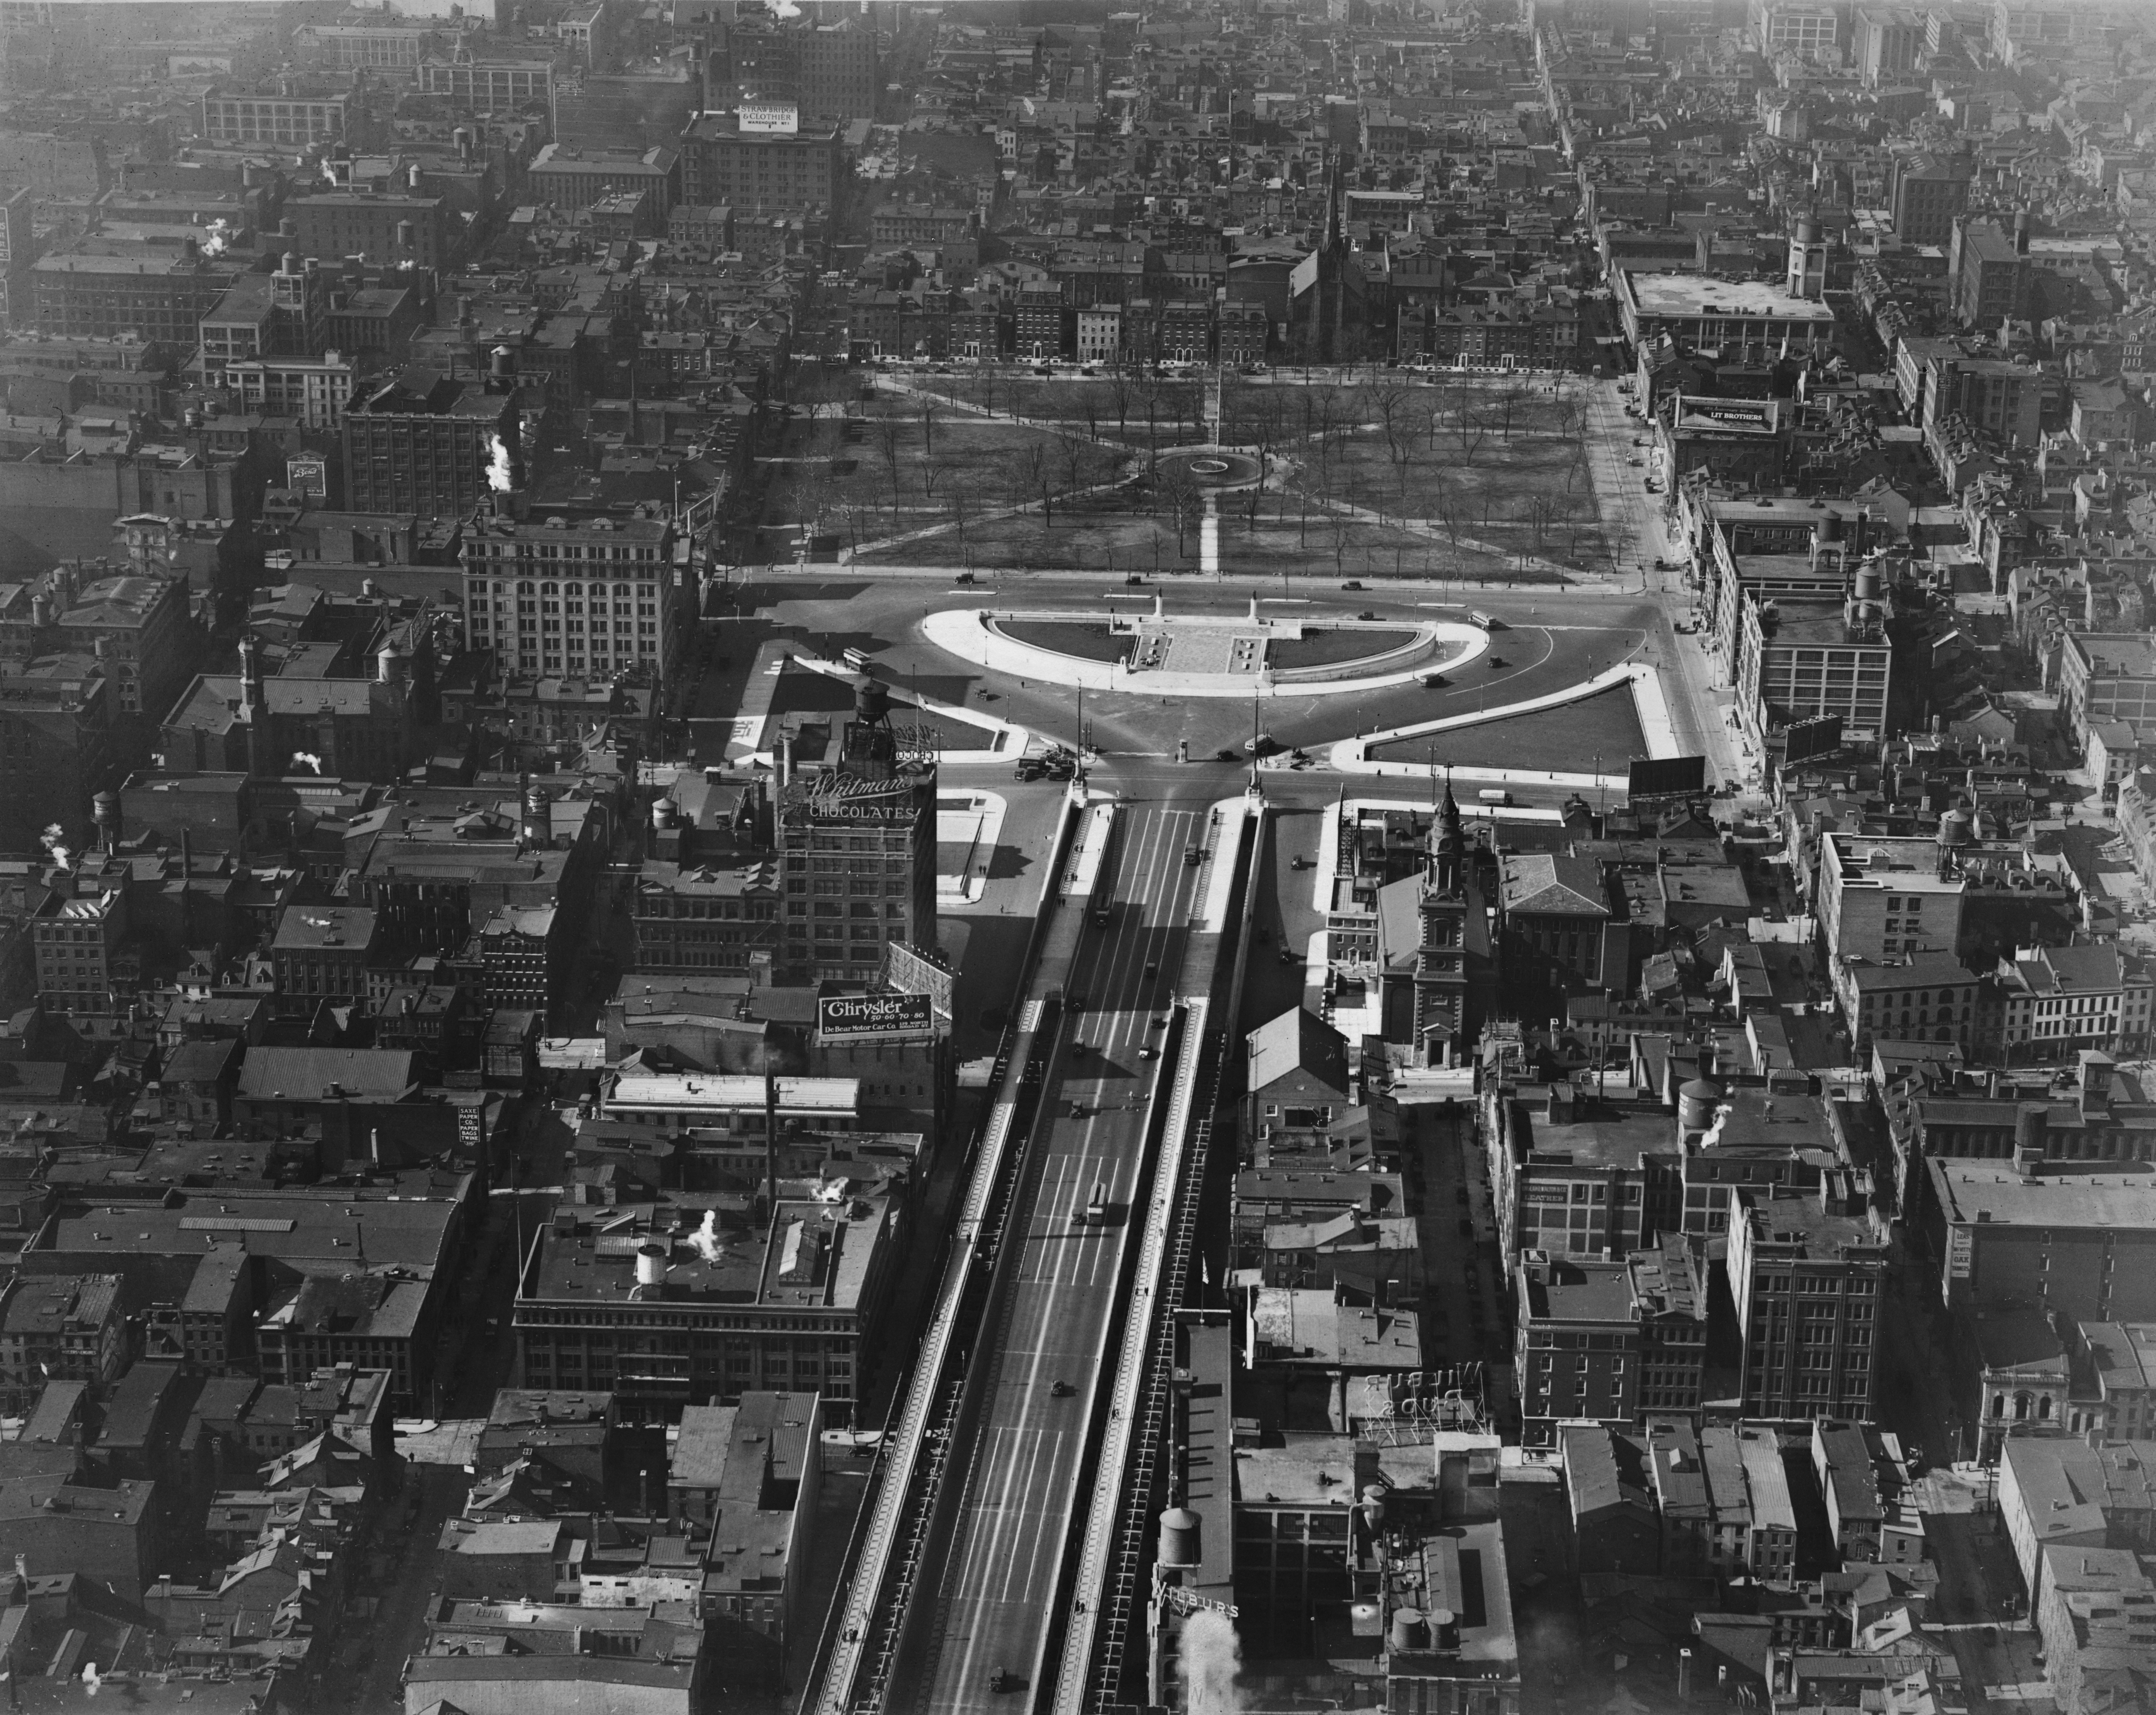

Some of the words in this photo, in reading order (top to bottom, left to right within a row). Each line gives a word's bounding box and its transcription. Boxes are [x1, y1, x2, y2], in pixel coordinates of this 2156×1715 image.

[293, 468, 317, 478] Bond
[807, 771, 915, 802] Whitman's
[810, 806, 921, 823] CHOCOLATES!
[828, 1000, 902, 1020] Chrysler
